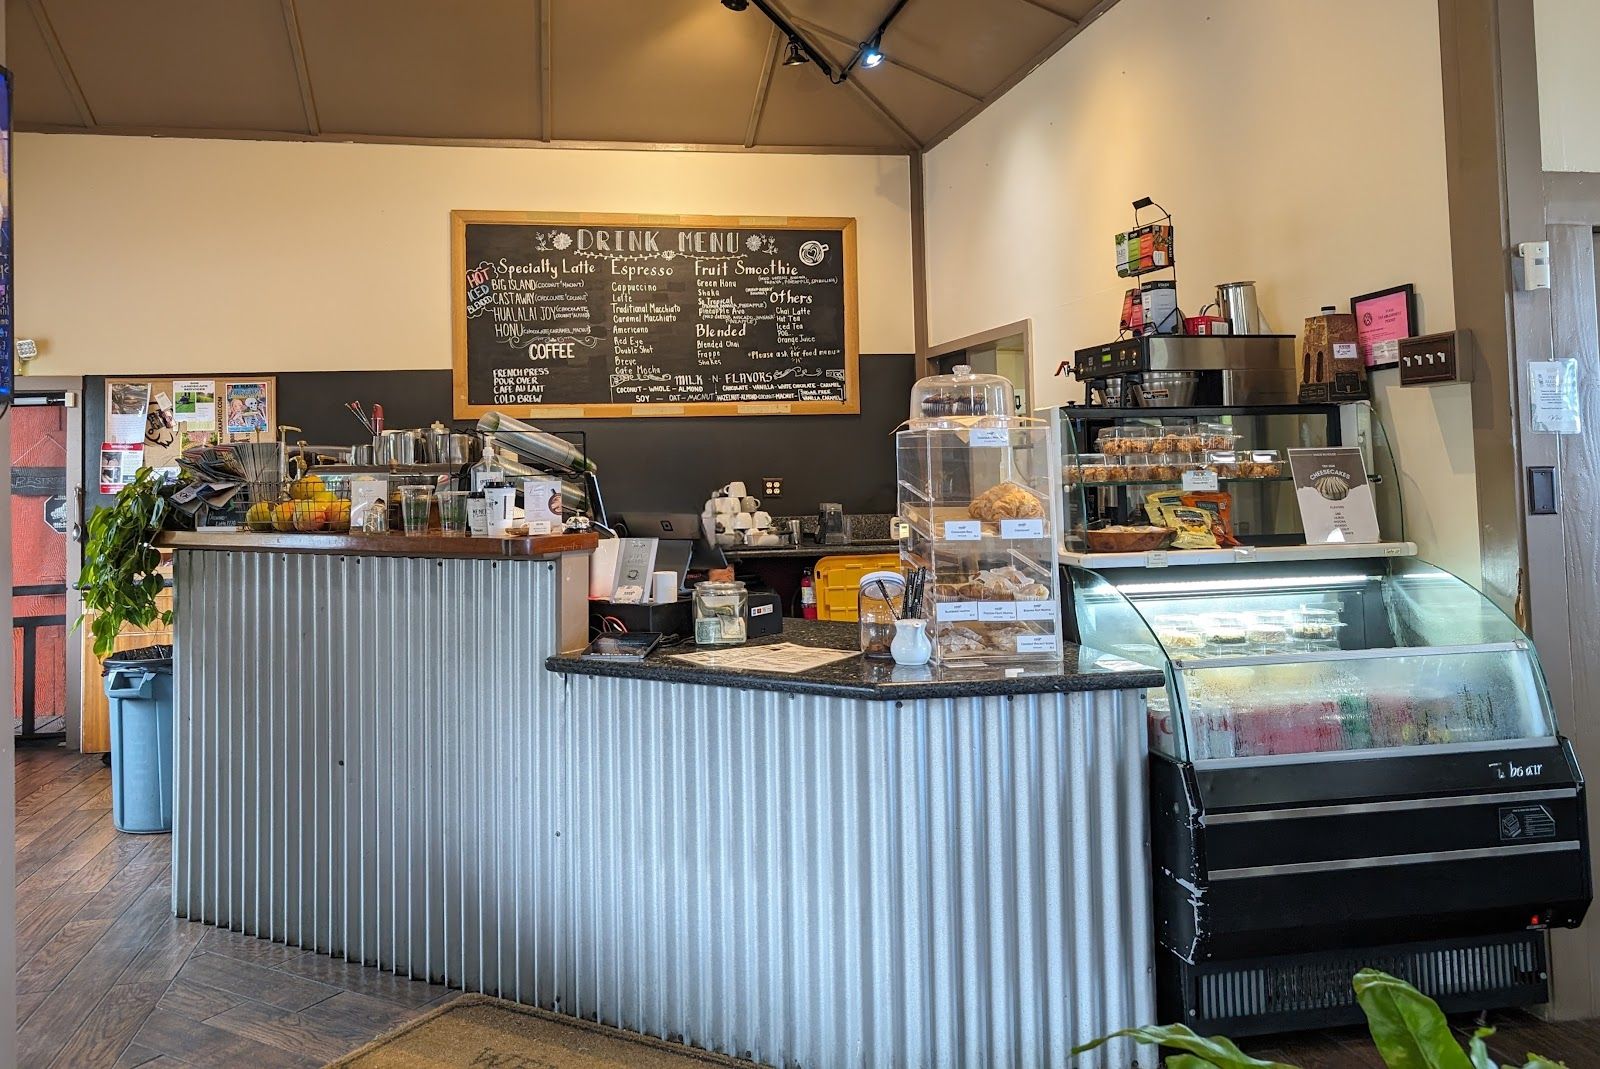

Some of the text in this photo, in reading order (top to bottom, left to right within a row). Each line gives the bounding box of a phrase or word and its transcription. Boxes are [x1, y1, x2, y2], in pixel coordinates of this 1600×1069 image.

[577, 229, 738, 254] DRINK MENU
[497, 258, 596, 279] Specialty Latte
[612, 258, 674, 281] Espresso
[695, 259, 799, 276] Fruit Smoothie
[466, 267, 490, 288] HOT
[492, 279, 506, 290] BIG
[508, 279, 536, 290] ISLAND
[612, 282, 657, 294] Cappuccino
[697, 279, 737, 288] Green Honu
[466, 284, 490, 302] ICED
[698, 288, 720, 296] Shaka
[770, 289, 813, 304] Others
[492, 292, 535, 305] CASTAWAY
[612, 294, 632, 302] Latte
[466, 296, 492, 314] BLENDED
[610, 303, 681, 313] Traditional Macchiato
[493, 307, 538, 322] HUALALAI
[540, 306, 556, 321] JOY
[775, 307, 811, 315] Chai Latte
[613, 314, 676, 323] Caramel Macchiato
[494, 323, 523, 337] HONU
[613, 325, 648, 334] Americano
[696, 322, 746, 338] Blended
[614, 336, 643, 348] Red Eye
[697, 340, 723, 349] Blended
[777, 337, 798, 345] Orange
[528, 343, 575, 360] COFFEE
[614, 345, 654, 354] Double Shot
[697, 350, 720, 359] Frappe
[614, 356, 637, 366] Breve
[493, 368, 549, 378] FRENCH PRESS
[637, 365, 660, 374] Mocha
[494, 376, 538, 386] POUR OVER
[674, 374, 703, 385] MILK
[725, 372, 774, 384] FLAVORS
[493, 385, 512, 394] CAFE
[528, 384, 545, 393] LAIT
[494, 394, 542, 404] COLD BREW
[1310, 469, 1350, 480] CHEESECAKES
